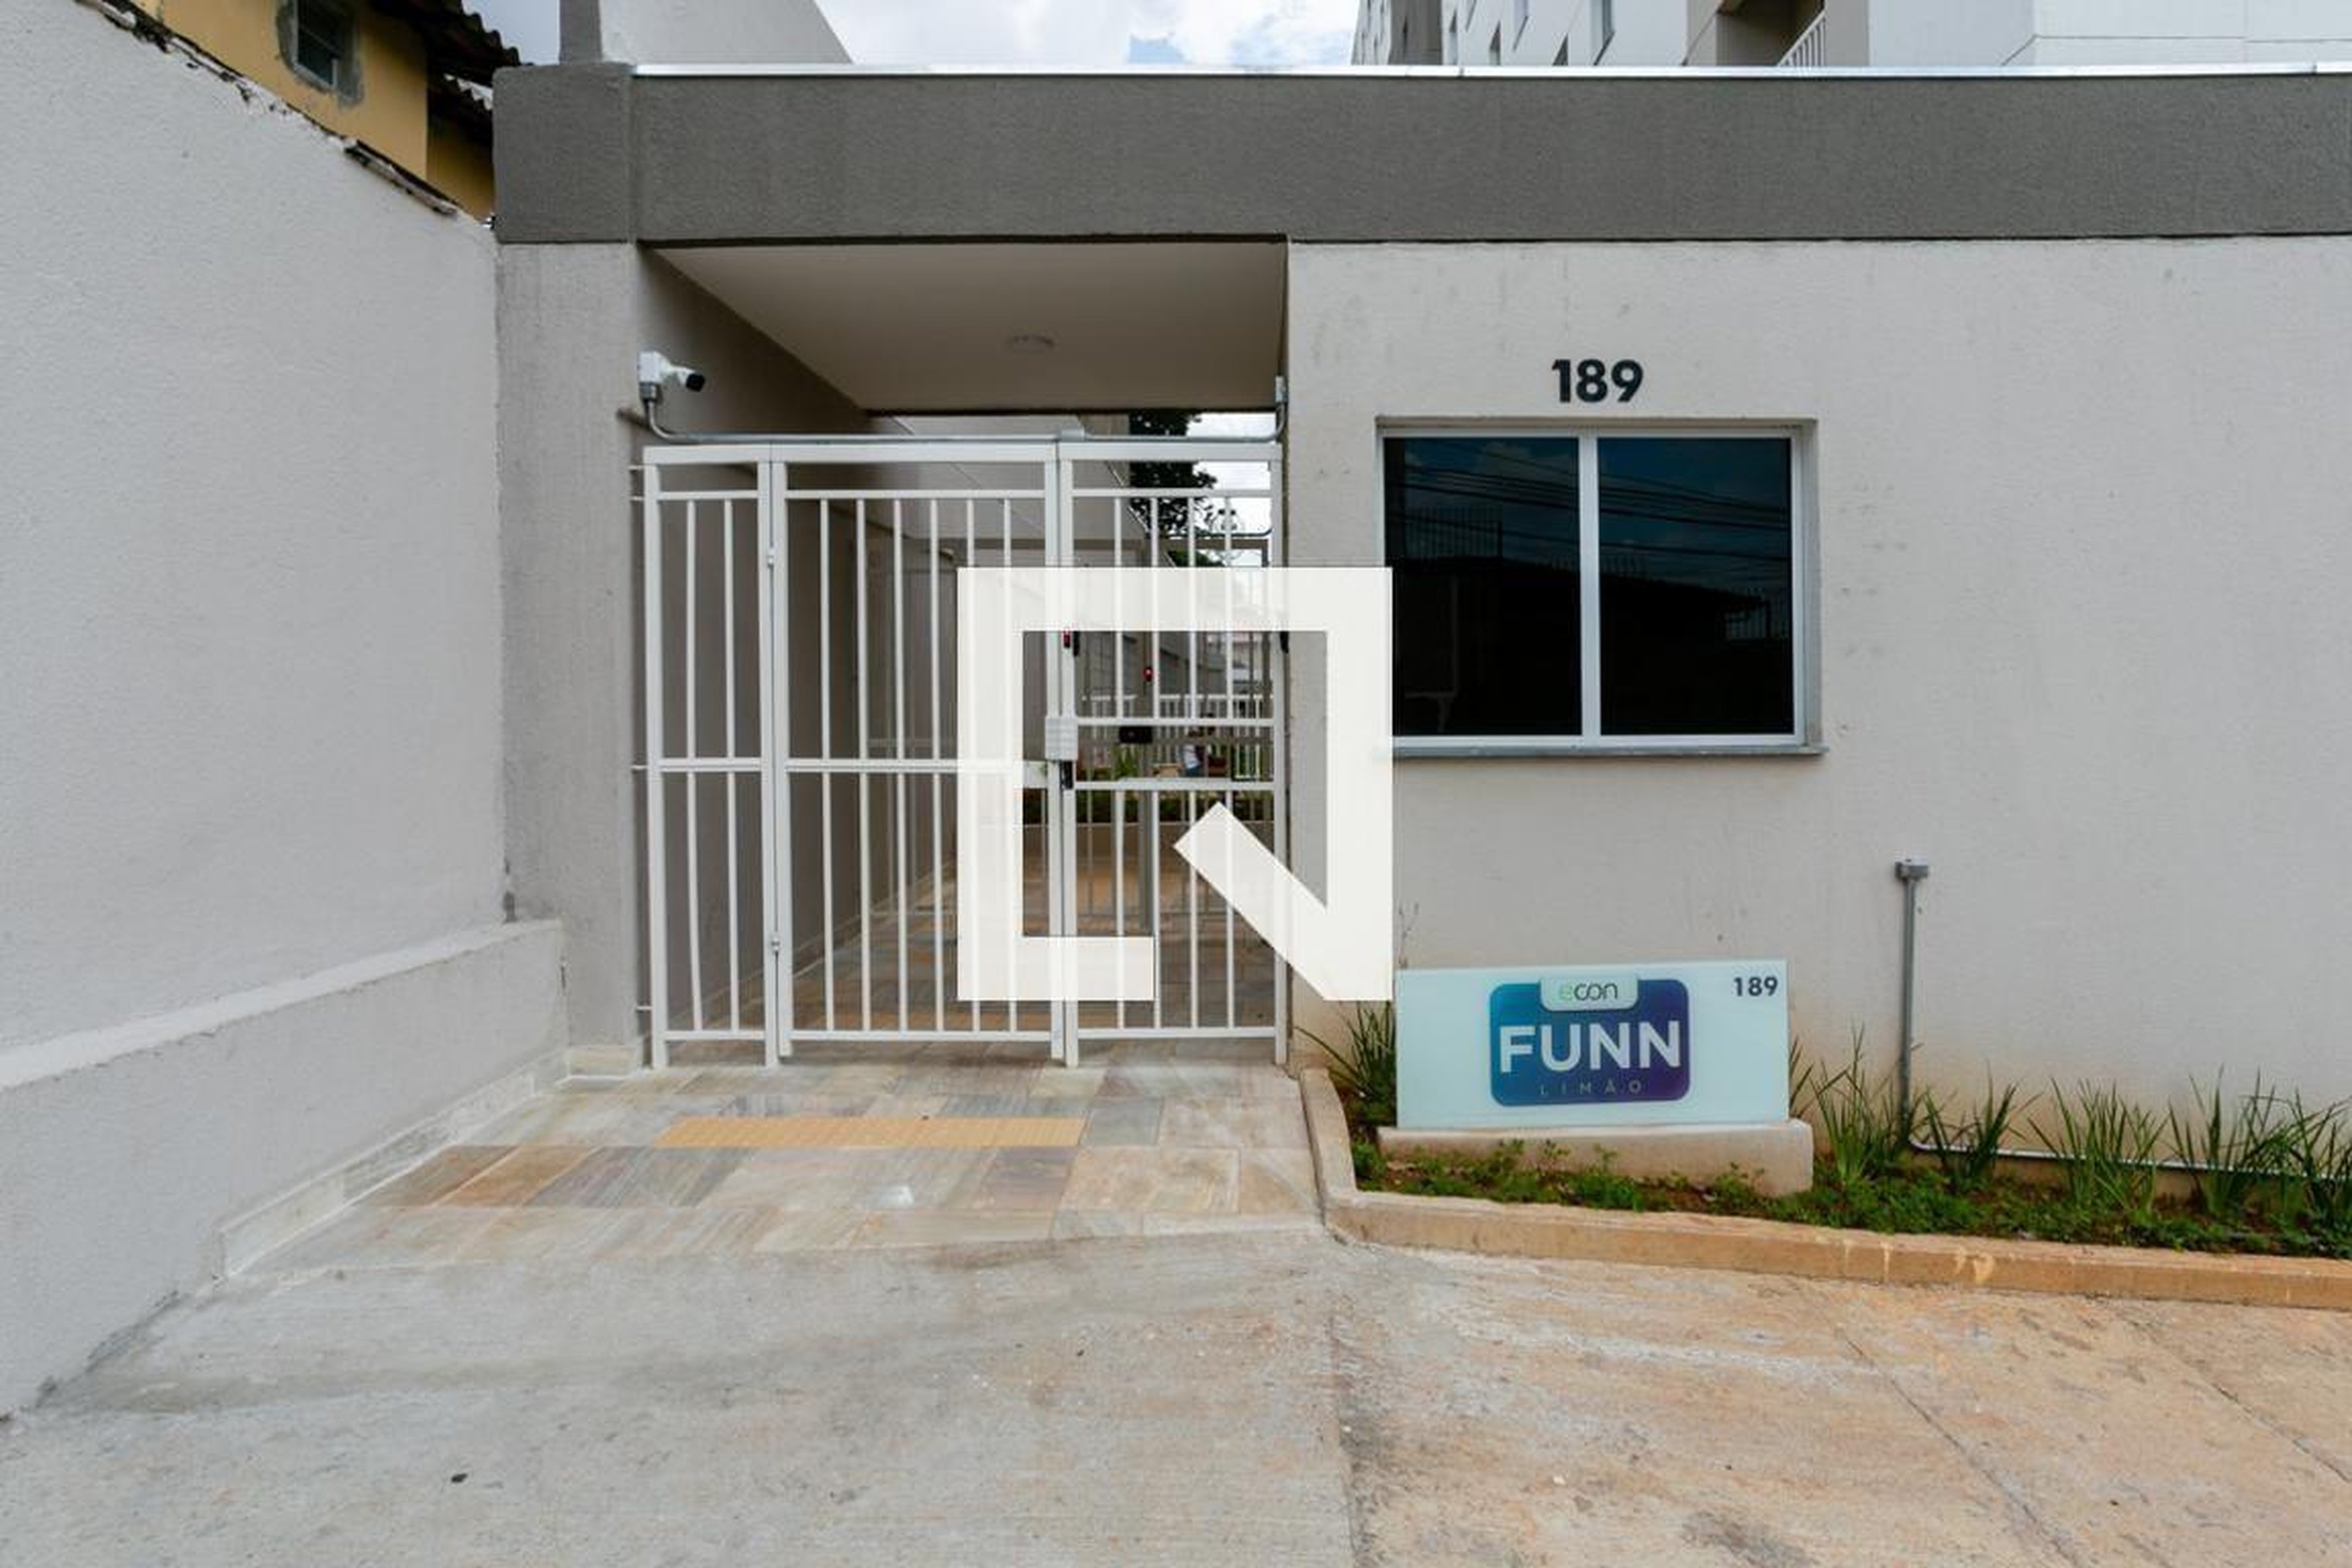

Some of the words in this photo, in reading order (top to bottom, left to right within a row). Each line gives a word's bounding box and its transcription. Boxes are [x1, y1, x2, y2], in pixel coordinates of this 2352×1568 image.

[1551, 359, 1643, 403] 189
[1559, 982, 1618, 1001] econ
[1733, 976, 1778, 997] 189
[1499, 1020, 1680, 1072] FUNN
